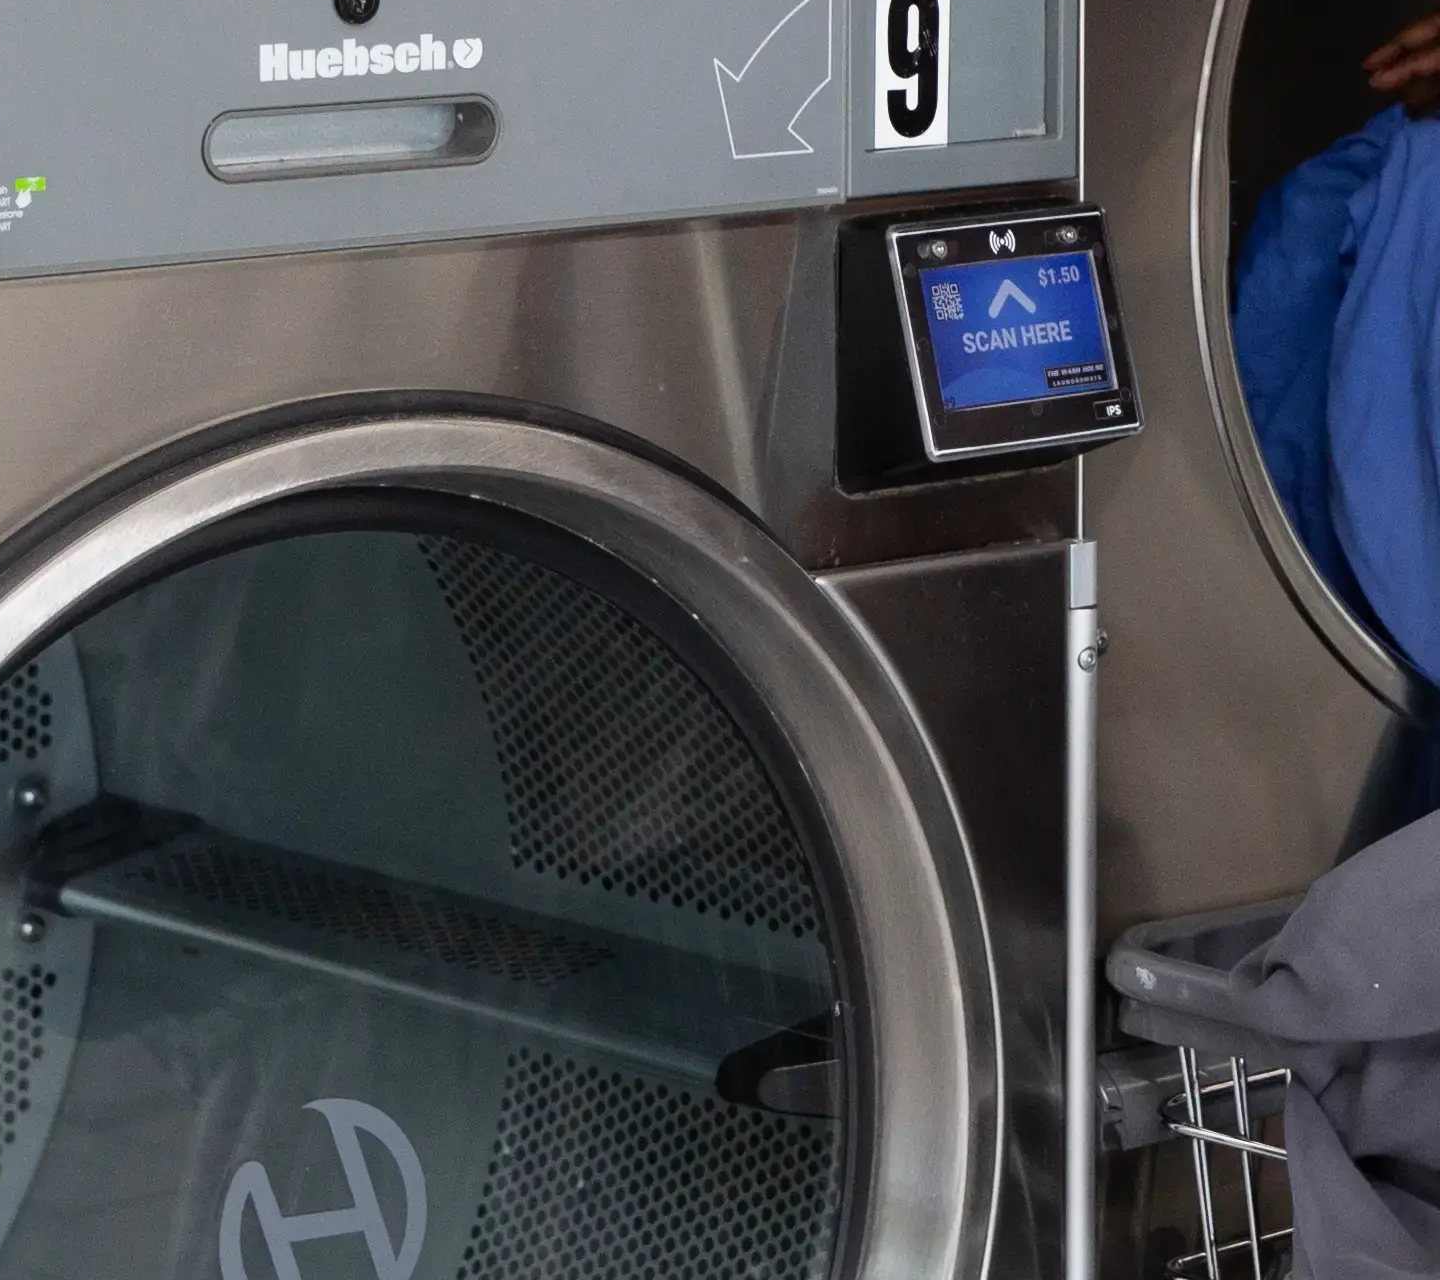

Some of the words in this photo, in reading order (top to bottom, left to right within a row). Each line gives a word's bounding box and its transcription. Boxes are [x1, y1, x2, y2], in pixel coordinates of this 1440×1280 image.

[259, 34, 447, 82] Huebsch
[1038, 265, 1080, 288] $1.50
[963, 327, 1017, 354] SCAN
[1020, 320, 1073, 346] HERE
[1106, 404, 1122, 416] IPS
